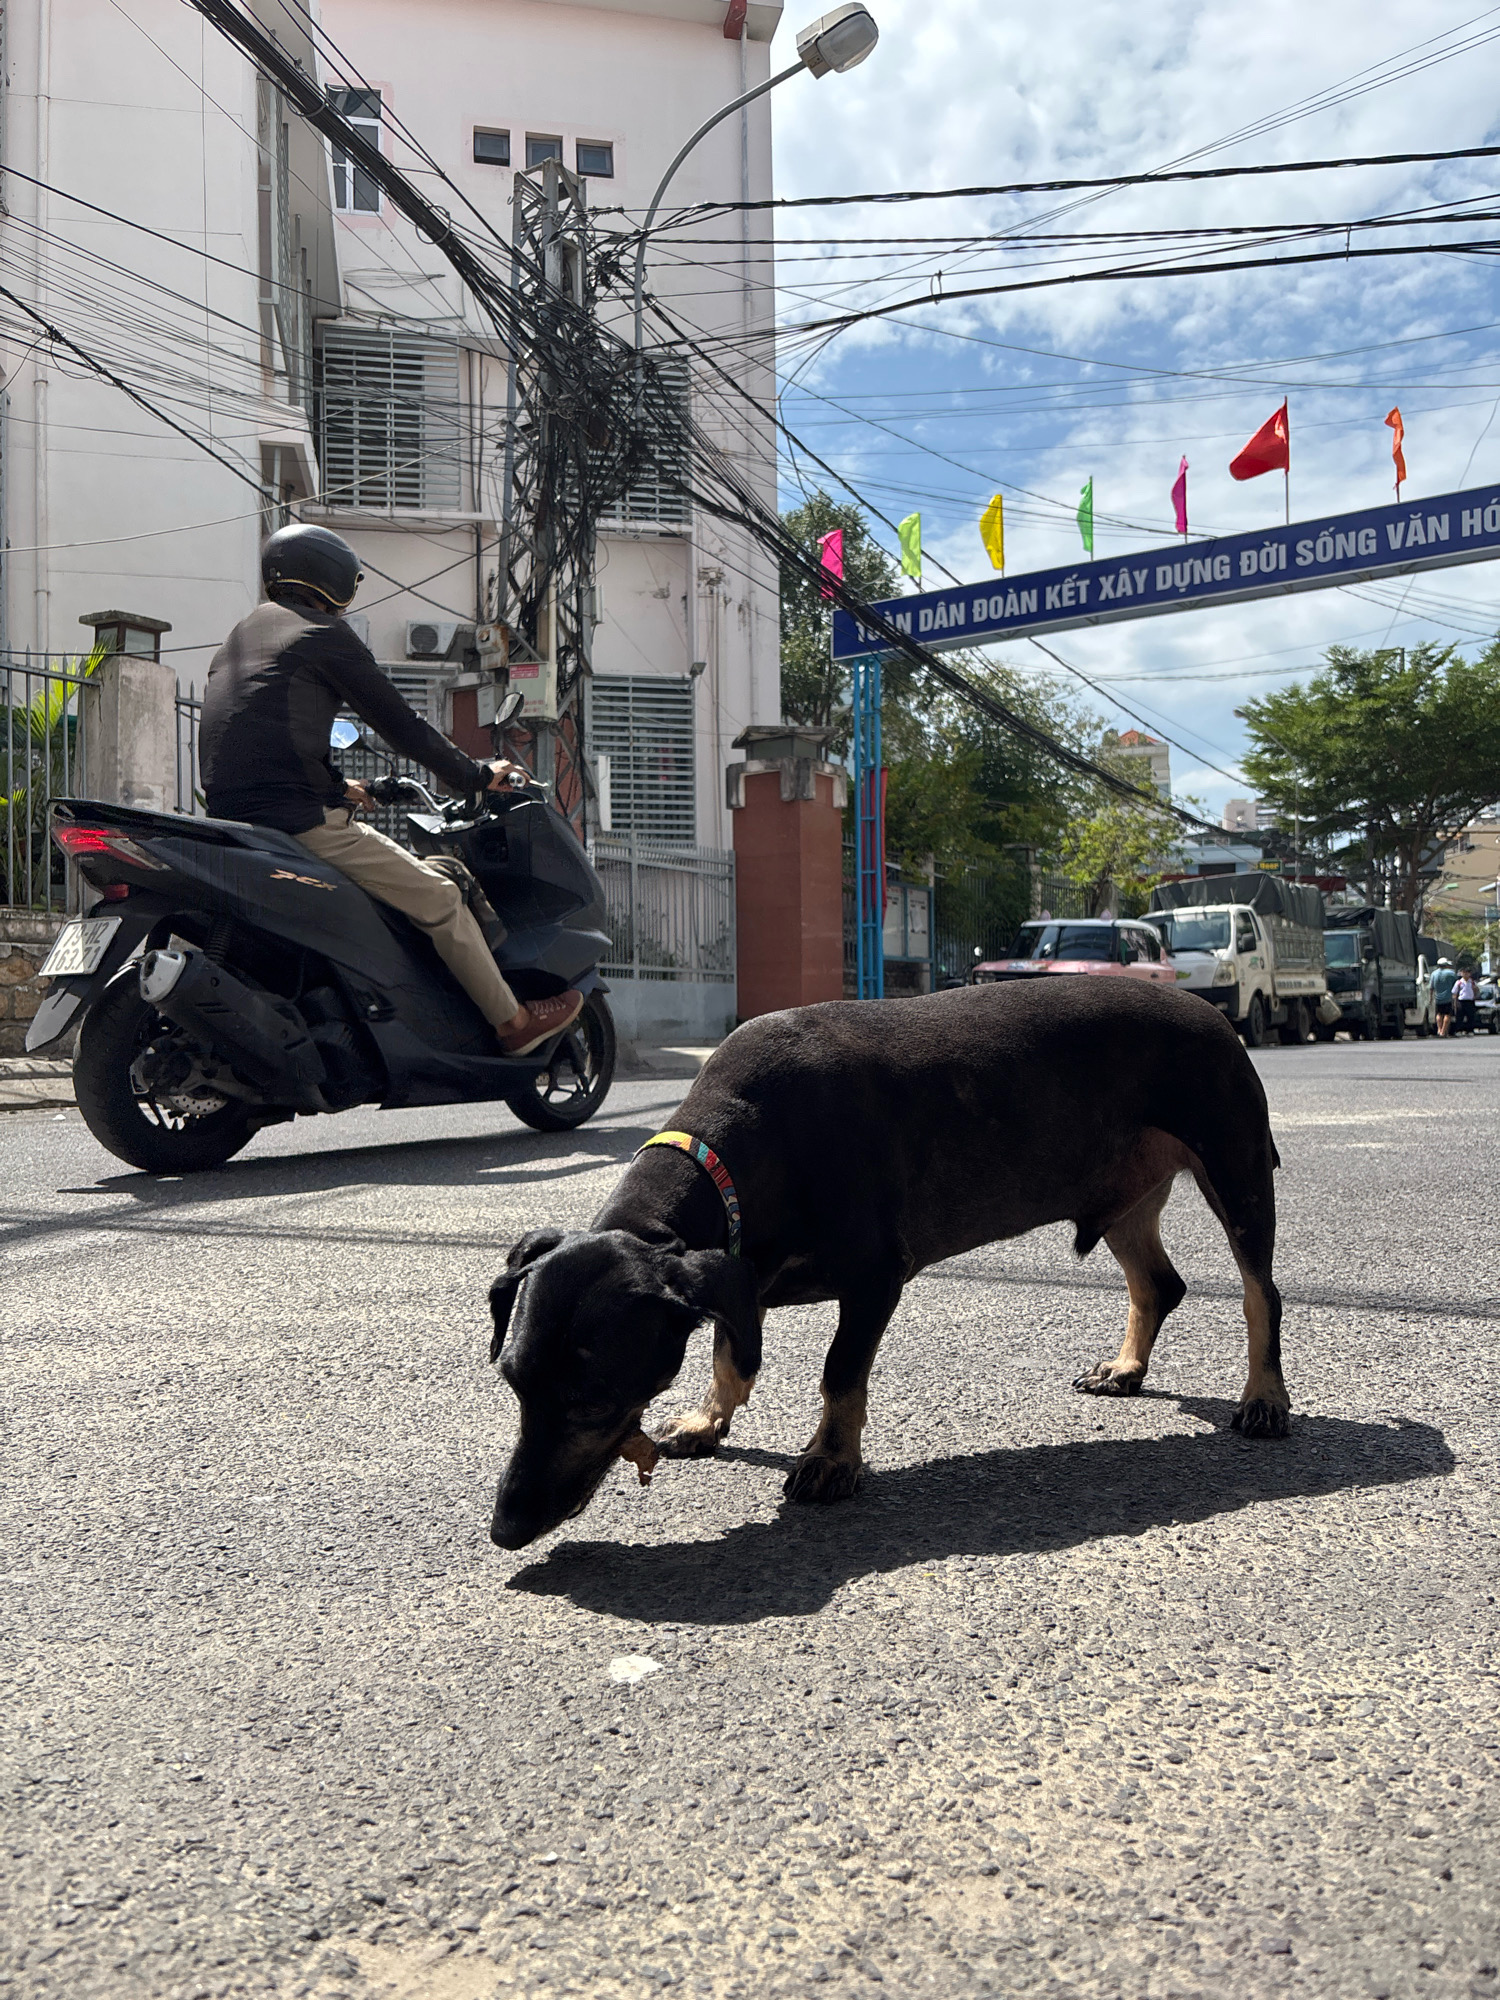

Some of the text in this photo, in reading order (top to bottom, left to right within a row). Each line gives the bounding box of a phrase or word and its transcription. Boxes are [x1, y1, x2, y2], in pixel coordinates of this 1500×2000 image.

[918, 601, 966, 633] DÂN
[972, 588, 1038, 623] ĐOÀN
[1045, 573, 1090, 611] KẾT
[1098, 567, 1149, 601] XÂY
[1155, 554, 1231, 592] DỰNG
[1239, 540, 1287, 577] ĐỜI
[1295, 526, 1377, 567] SỐNG
[1386, 512, 1450, 551] VĂN
